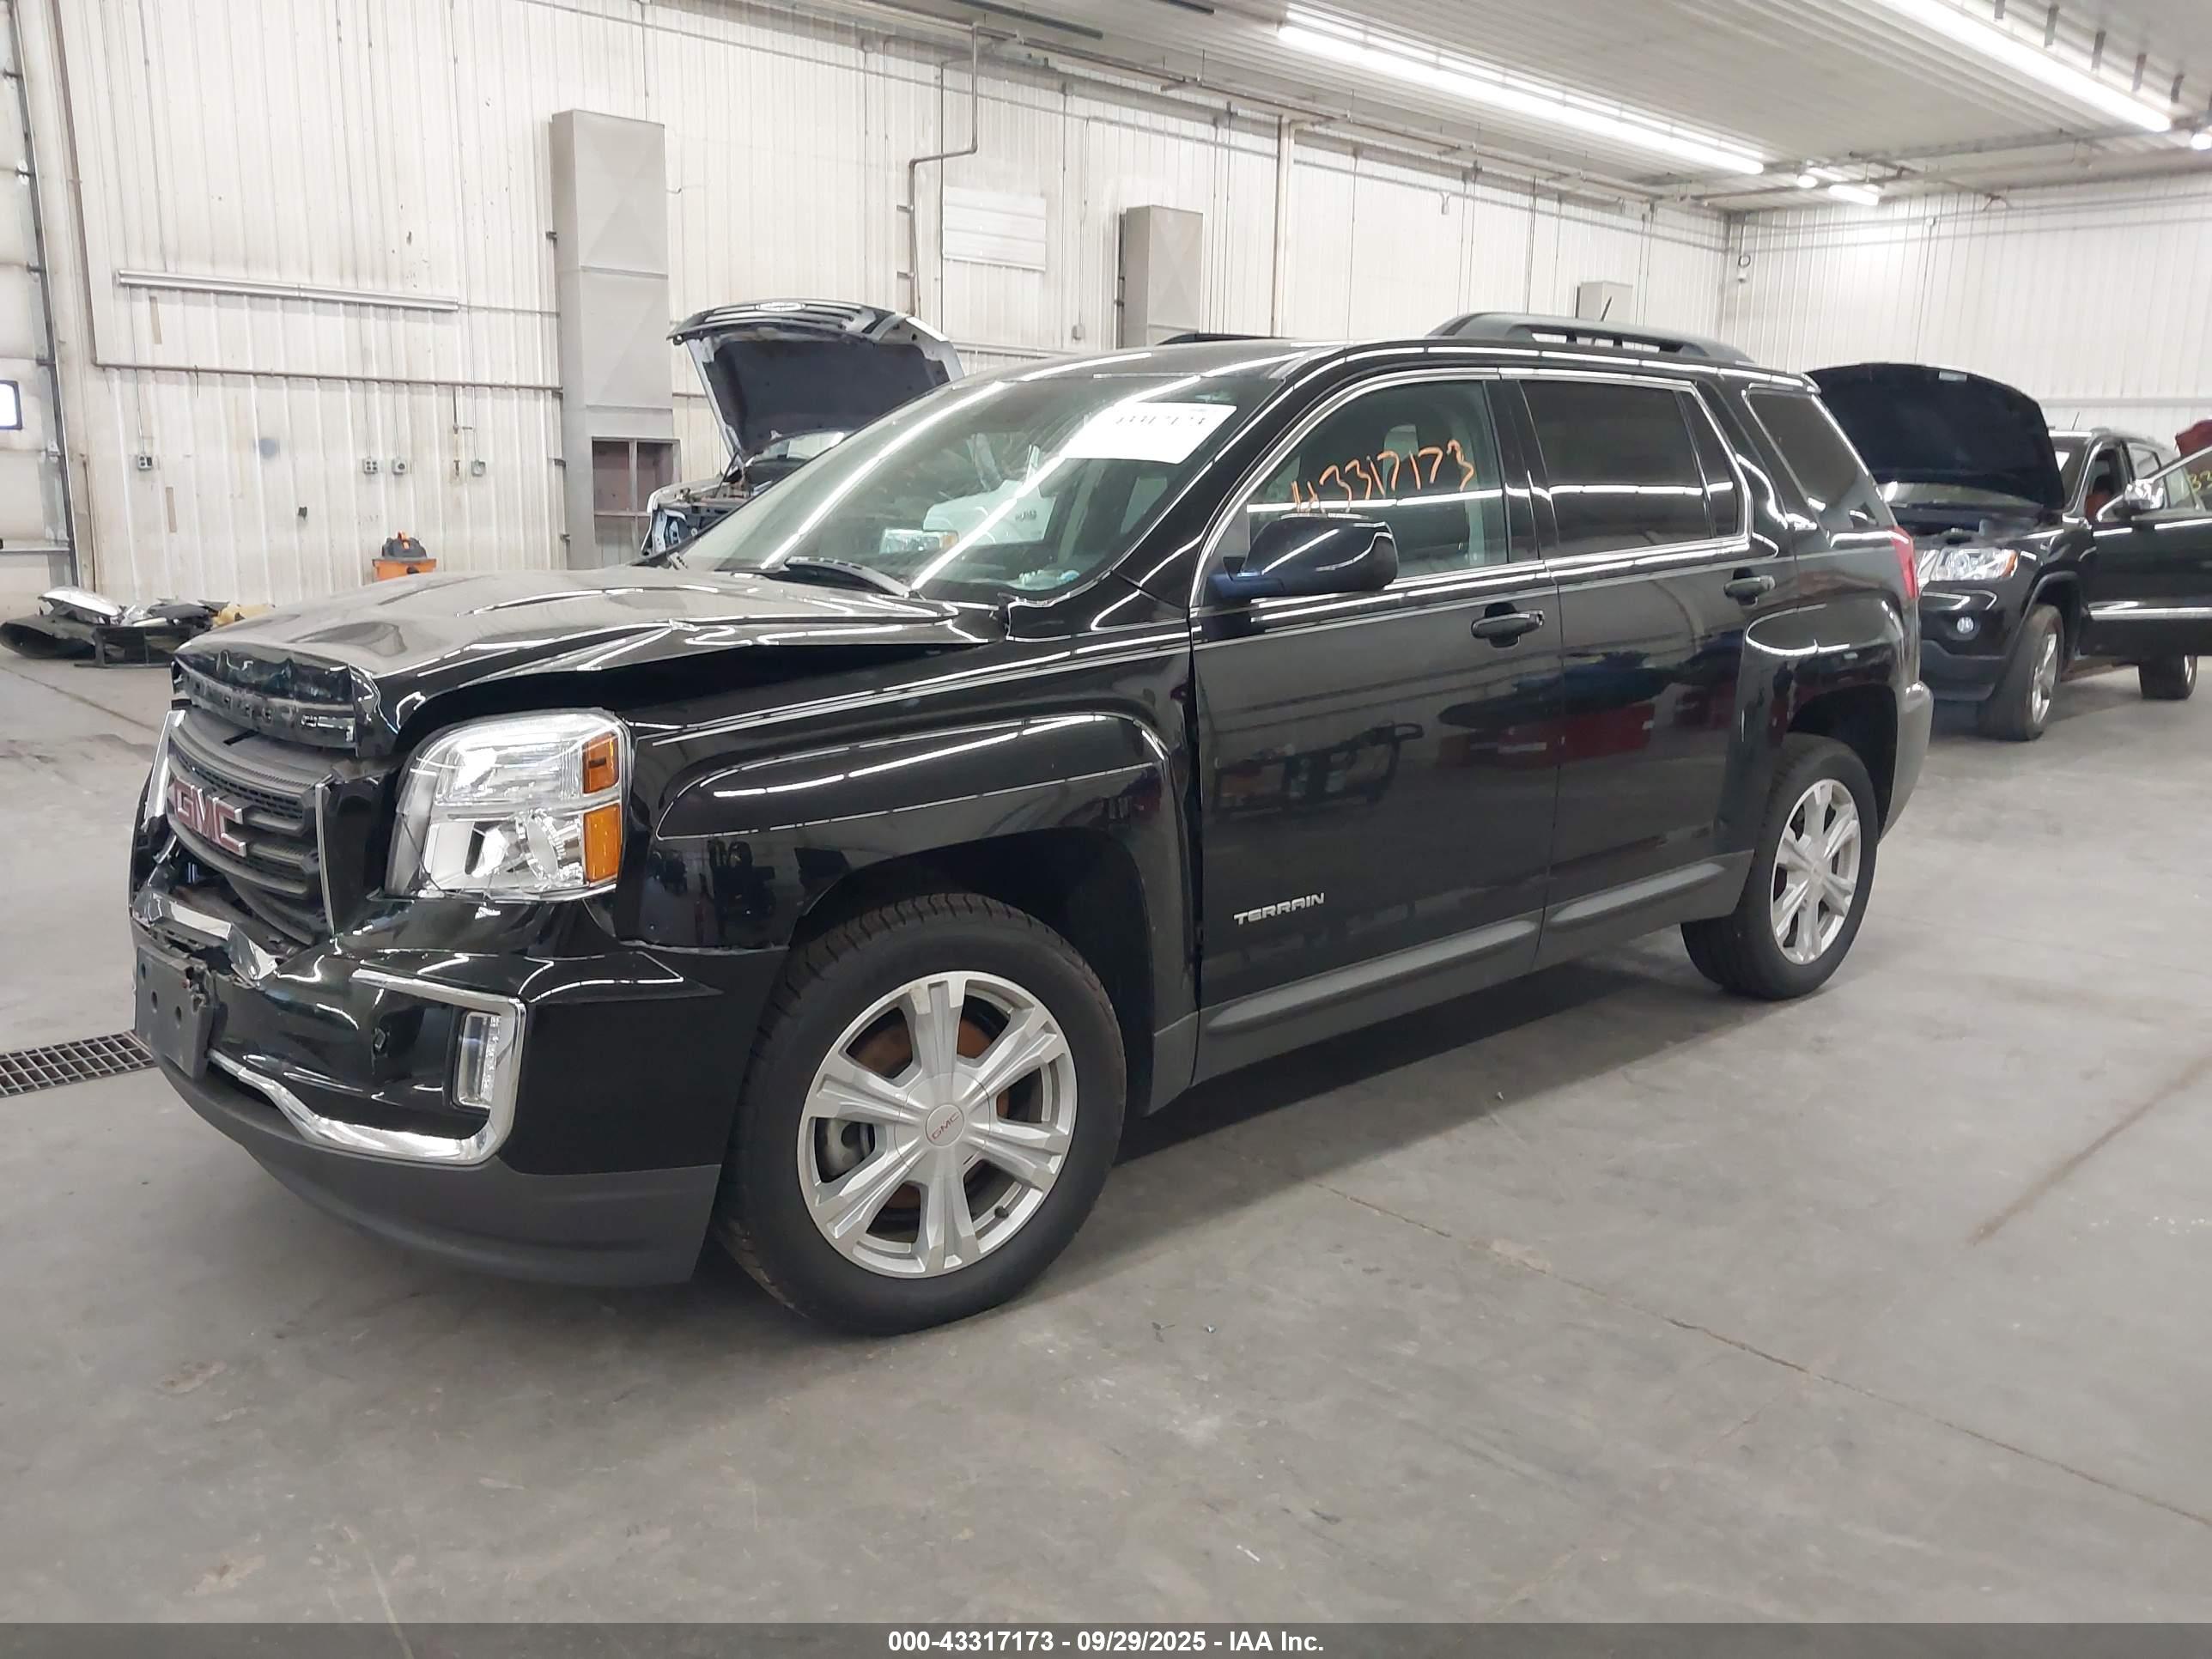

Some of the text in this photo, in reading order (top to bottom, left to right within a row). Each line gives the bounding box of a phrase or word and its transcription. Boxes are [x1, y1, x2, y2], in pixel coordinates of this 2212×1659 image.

[168, 777, 246, 859] GMC
[1233, 892, 1325, 926] TERRAIN
[931, 1110, 961, 1141] GMC
